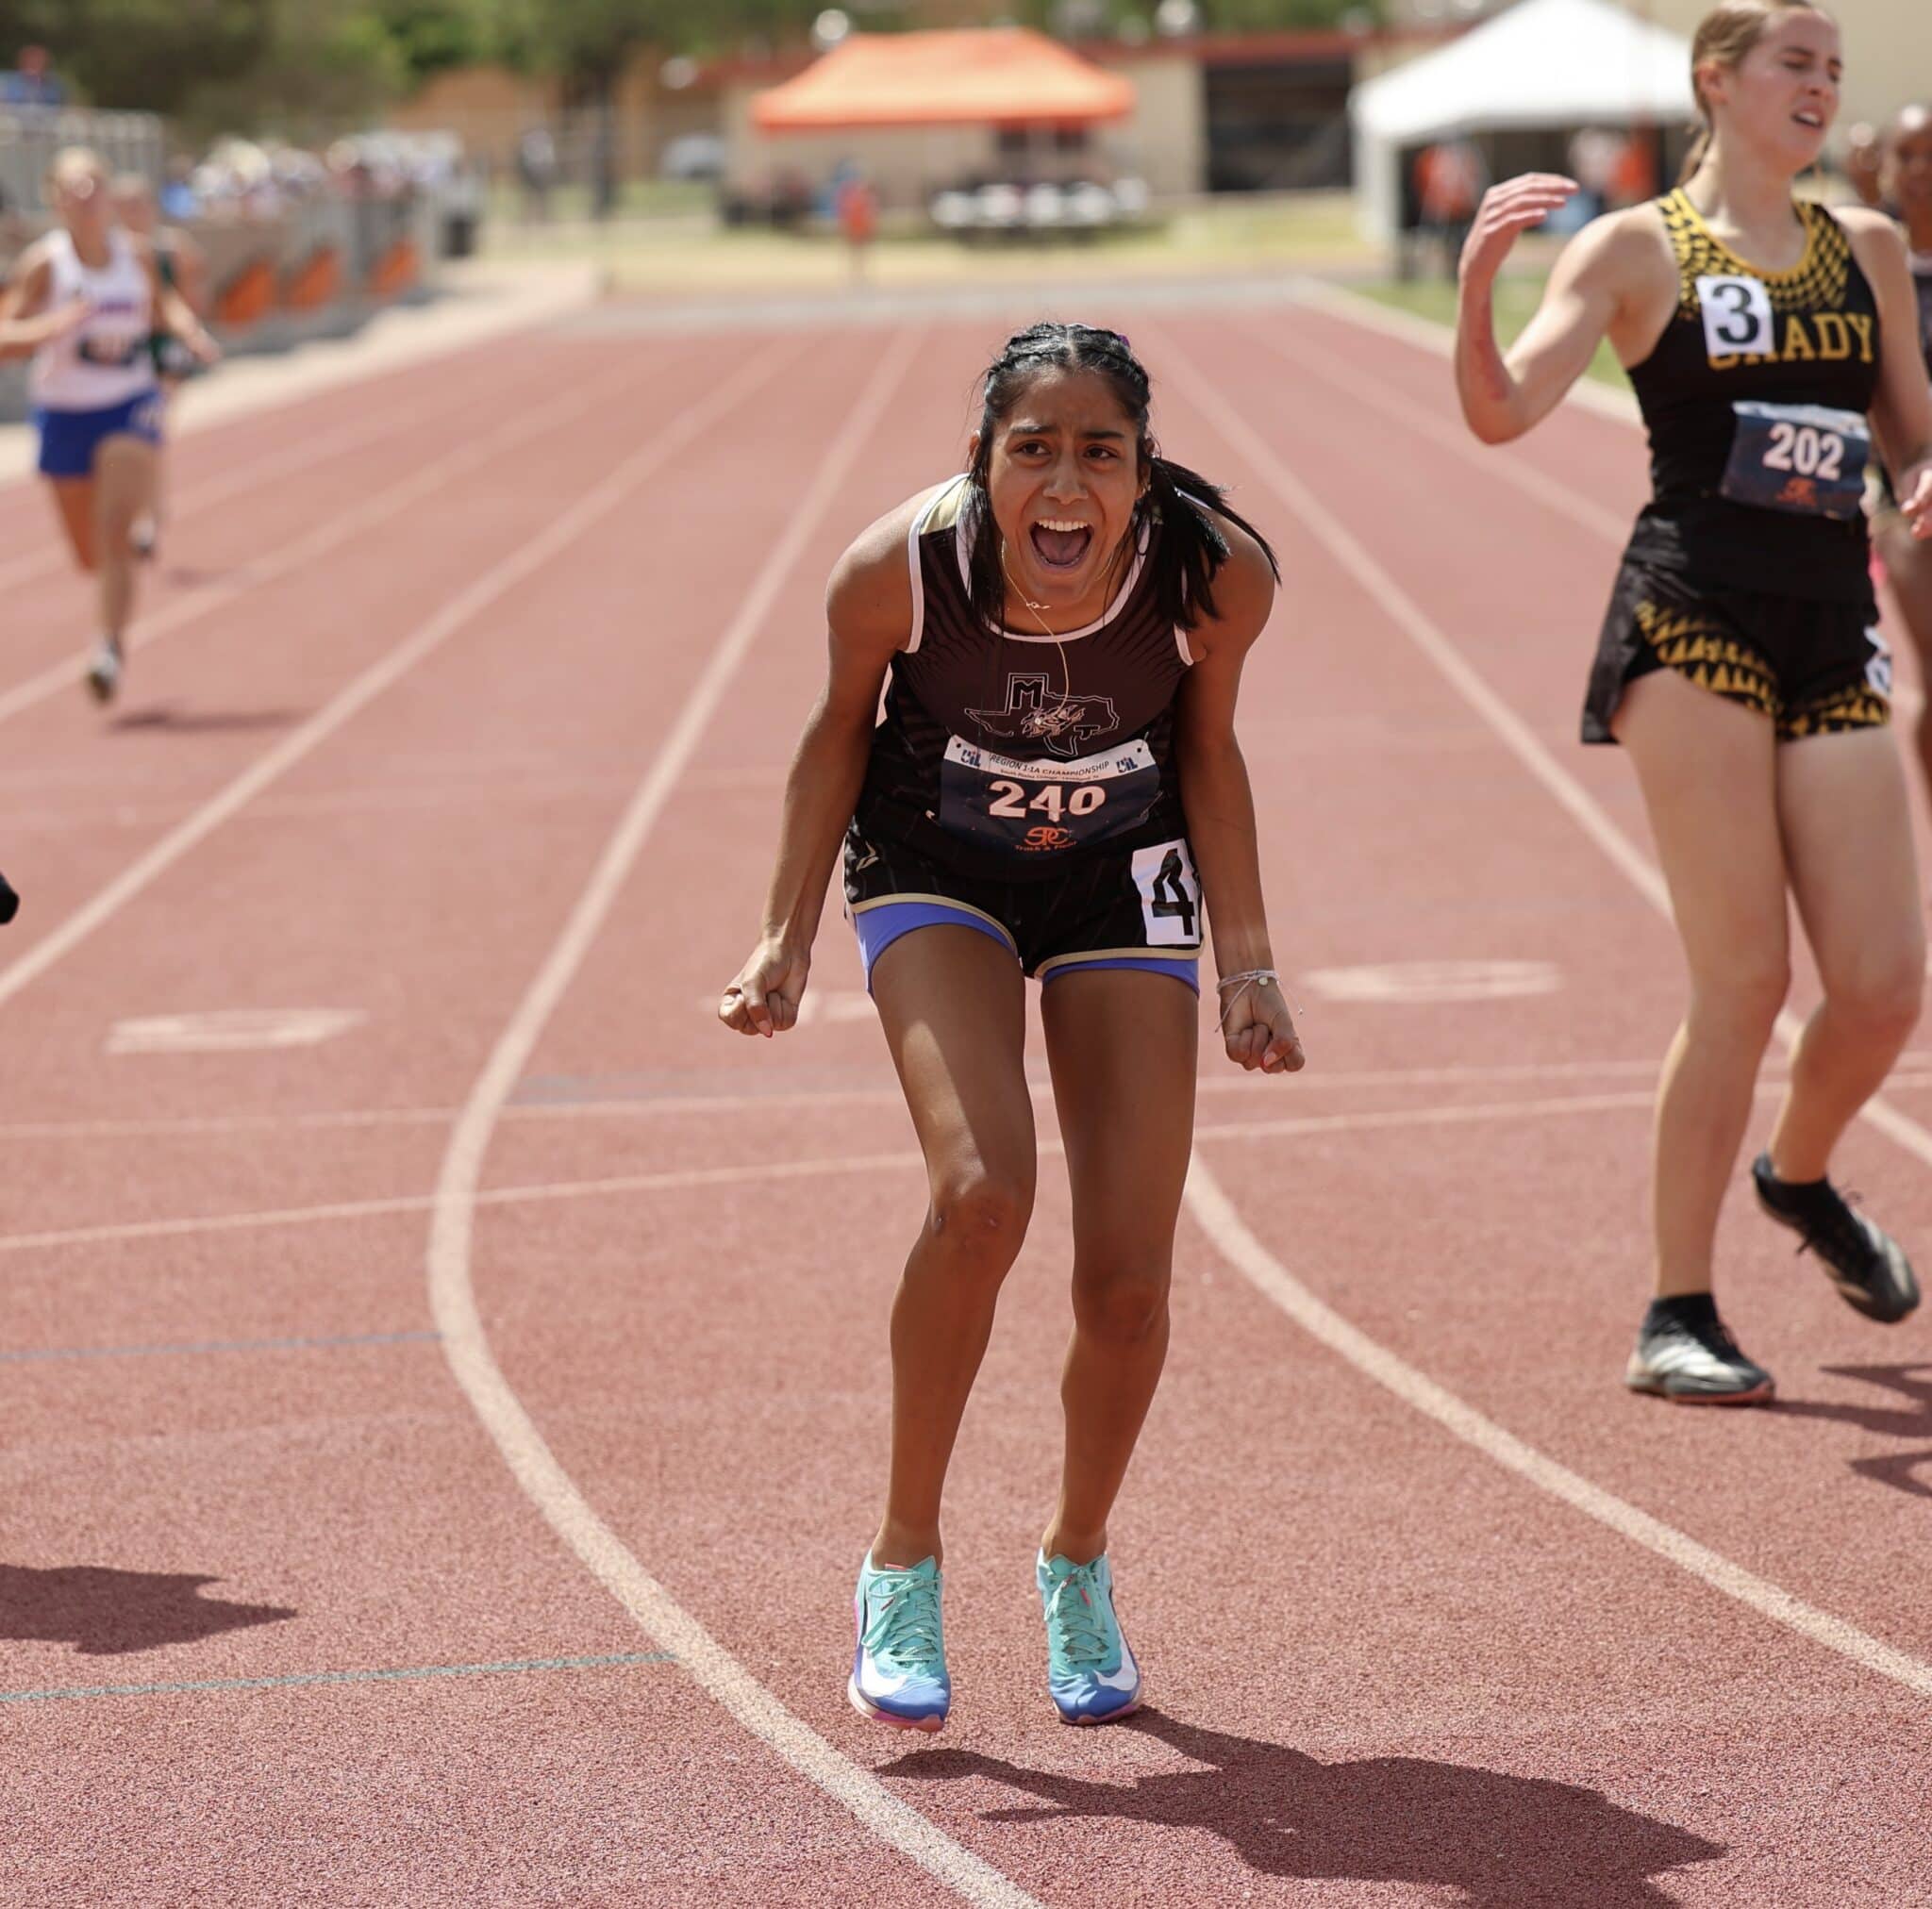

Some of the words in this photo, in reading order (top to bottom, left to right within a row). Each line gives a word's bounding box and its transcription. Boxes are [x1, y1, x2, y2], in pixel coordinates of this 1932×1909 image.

[1708, 312, 1873, 370] ADY
[1713, 284, 1759, 345] 3
[1762, 423, 1845, 480] 202
[1011, 679, 1044, 709] M
[989, 754, 1024, 770] REGION
[989, 780, 1107, 822] 240
[1151, 848, 1195, 936] 4
